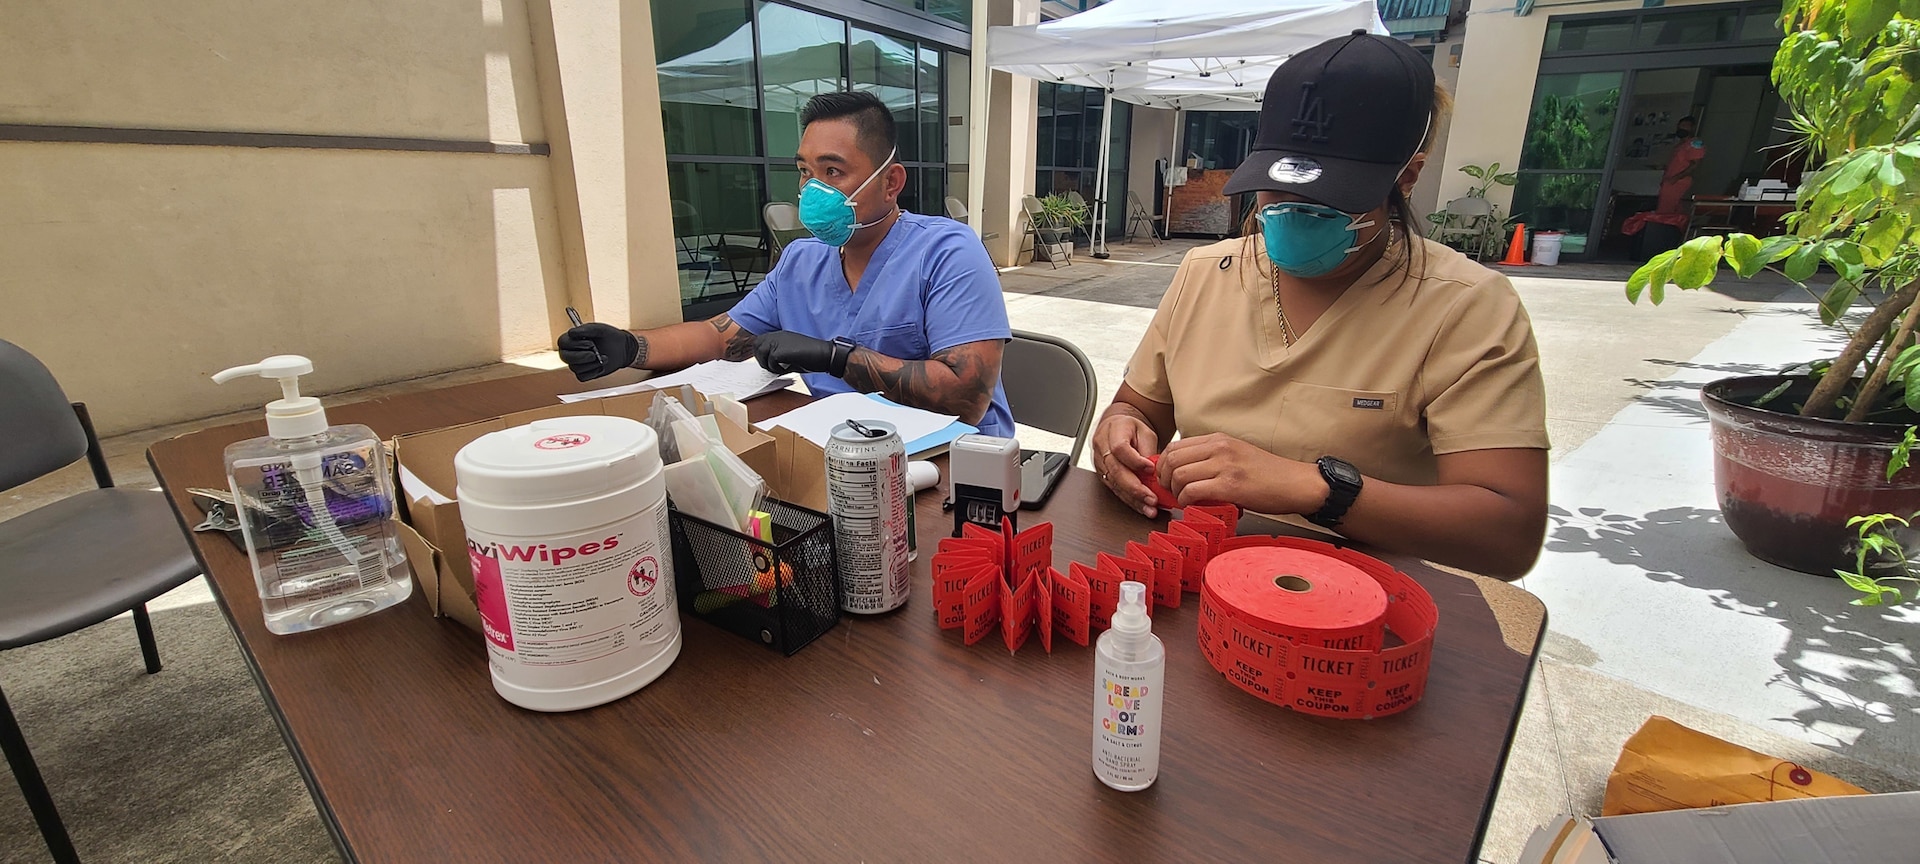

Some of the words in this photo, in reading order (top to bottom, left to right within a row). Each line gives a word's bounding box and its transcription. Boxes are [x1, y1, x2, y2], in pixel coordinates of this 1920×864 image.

[1022, 535, 1046, 557] TICKET
[968, 581, 994, 606] TICKET
[1232, 627, 1273, 659] TICKET
[1236, 659, 1263, 678] KEEP
[1302, 655, 1354, 676] TICKET
[1383, 652, 1419, 675] TICKET
[1228, 668, 1269, 695] COUPON
[1240, 670, 1256, 681] THIS
[1102, 678, 1149, 698] SPREAD
[1307, 686, 1342, 699] KEEP
[1385, 683, 1410, 698] KEEP
[1107, 694, 1140, 711] LOVE
[1297, 699, 1349, 713] COUPON
[1314, 696, 1335, 704] THIS
[1375, 695, 1413, 712] COUPON
[1110, 708, 1137, 723] NOT
[1102, 717, 1145, 736] GERMS
[1110, 738, 1120, 747] SALT
[1105, 756, 1119, 767] HAND
[1119, 760, 1137, 769] SPRAY
